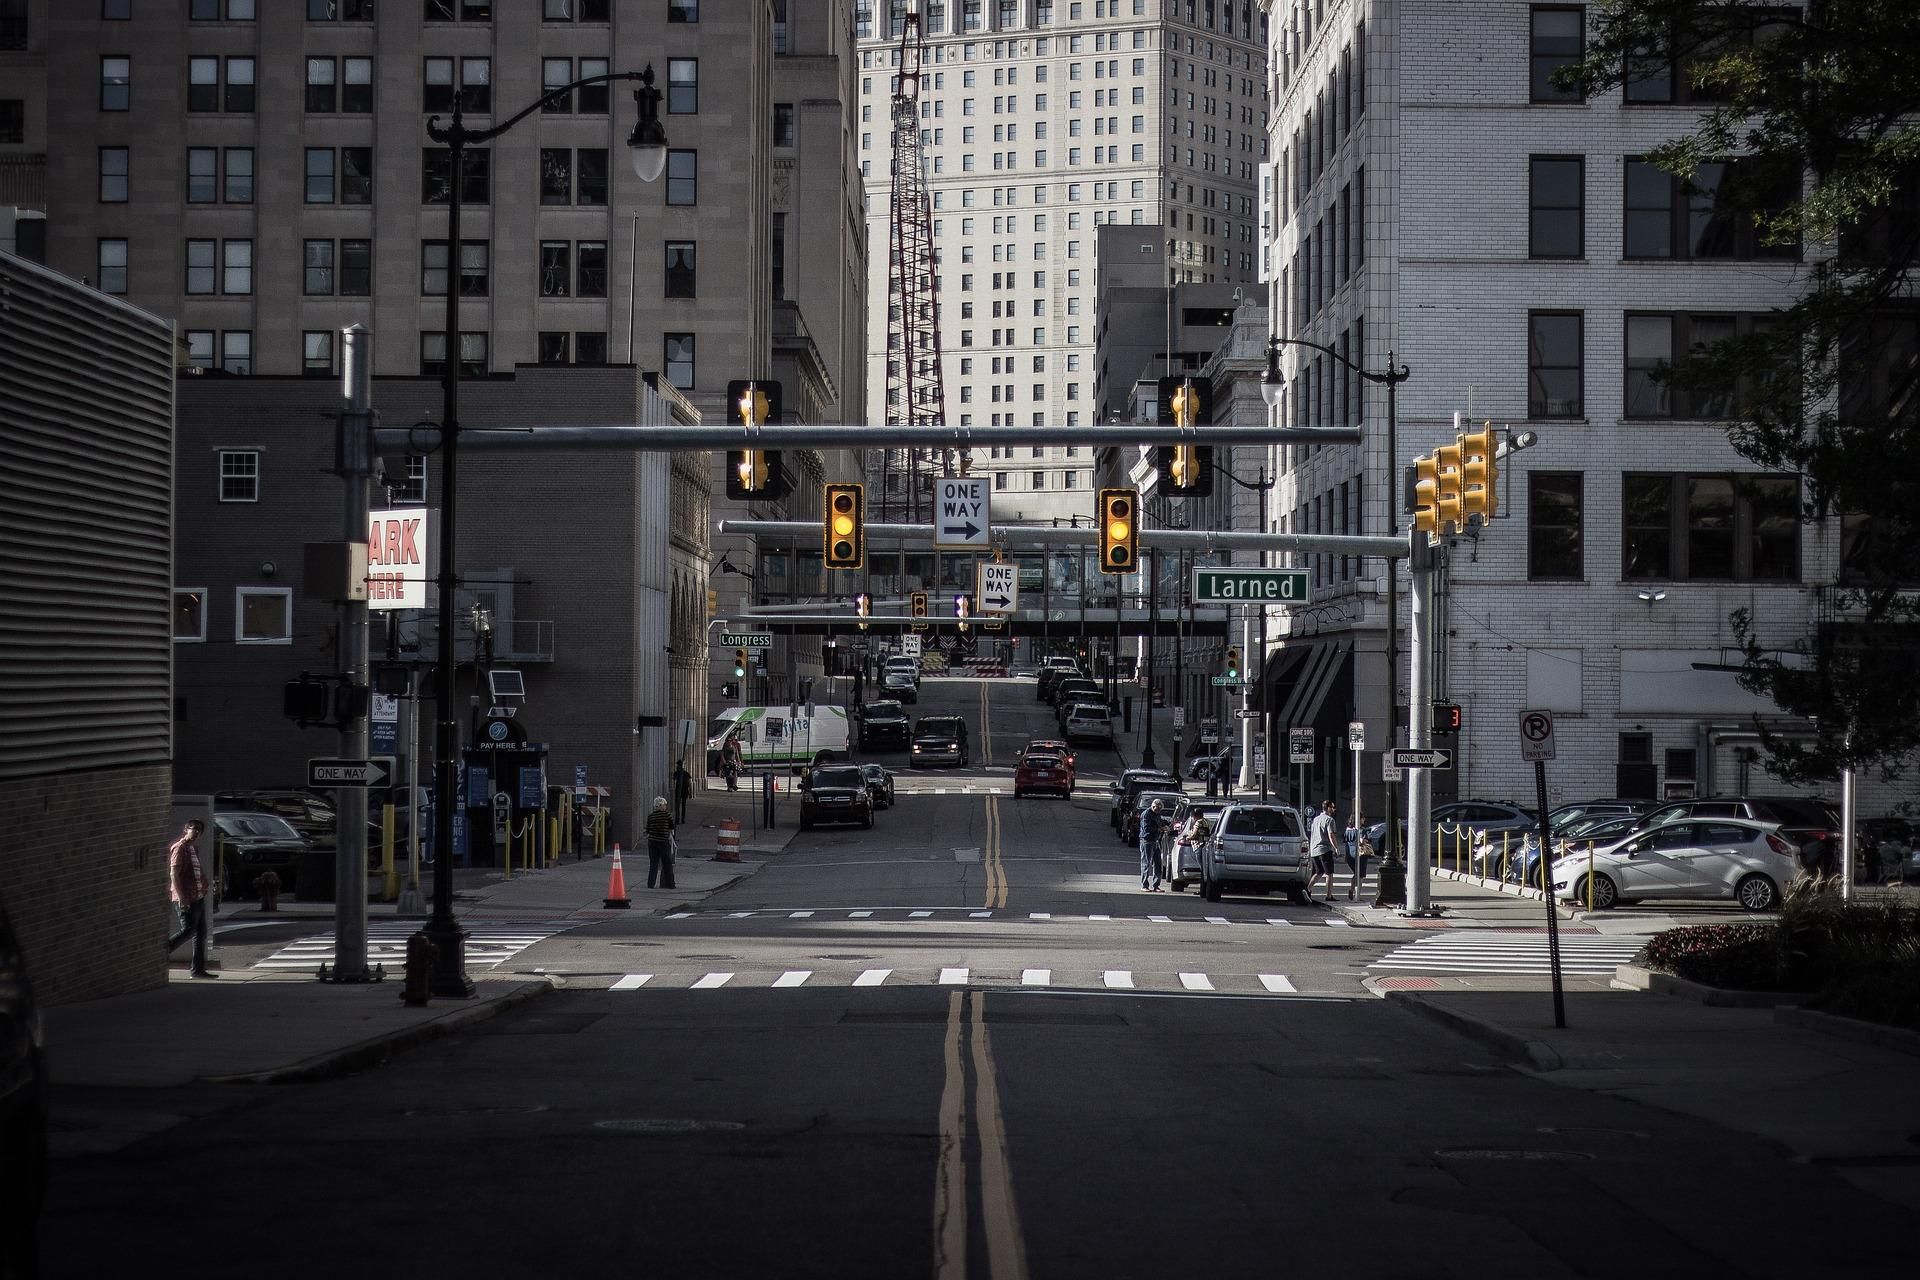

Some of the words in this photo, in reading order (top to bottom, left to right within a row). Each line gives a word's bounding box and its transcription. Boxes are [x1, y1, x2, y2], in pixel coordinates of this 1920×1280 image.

[945, 485, 980, 499] ONE
[944, 503, 982, 517] WAY
[368, 519, 420, 565] ARK
[987, 568, 1012, 579] ONE
[986, 581, 1013, 593] WAY
[1211, 576, 1293, 598] Larned
[722, 635, 770, 646] Congress
[1452, 710, 1459, 726] 3
[1399, 755, 1415, 763] ONE
[1417, 755, 1433, 763] WAY
[1526, 750, 1553, 759] PARKING
[317, 768, 339, 779] ONE
[343, 768, 366, 779] WAY
